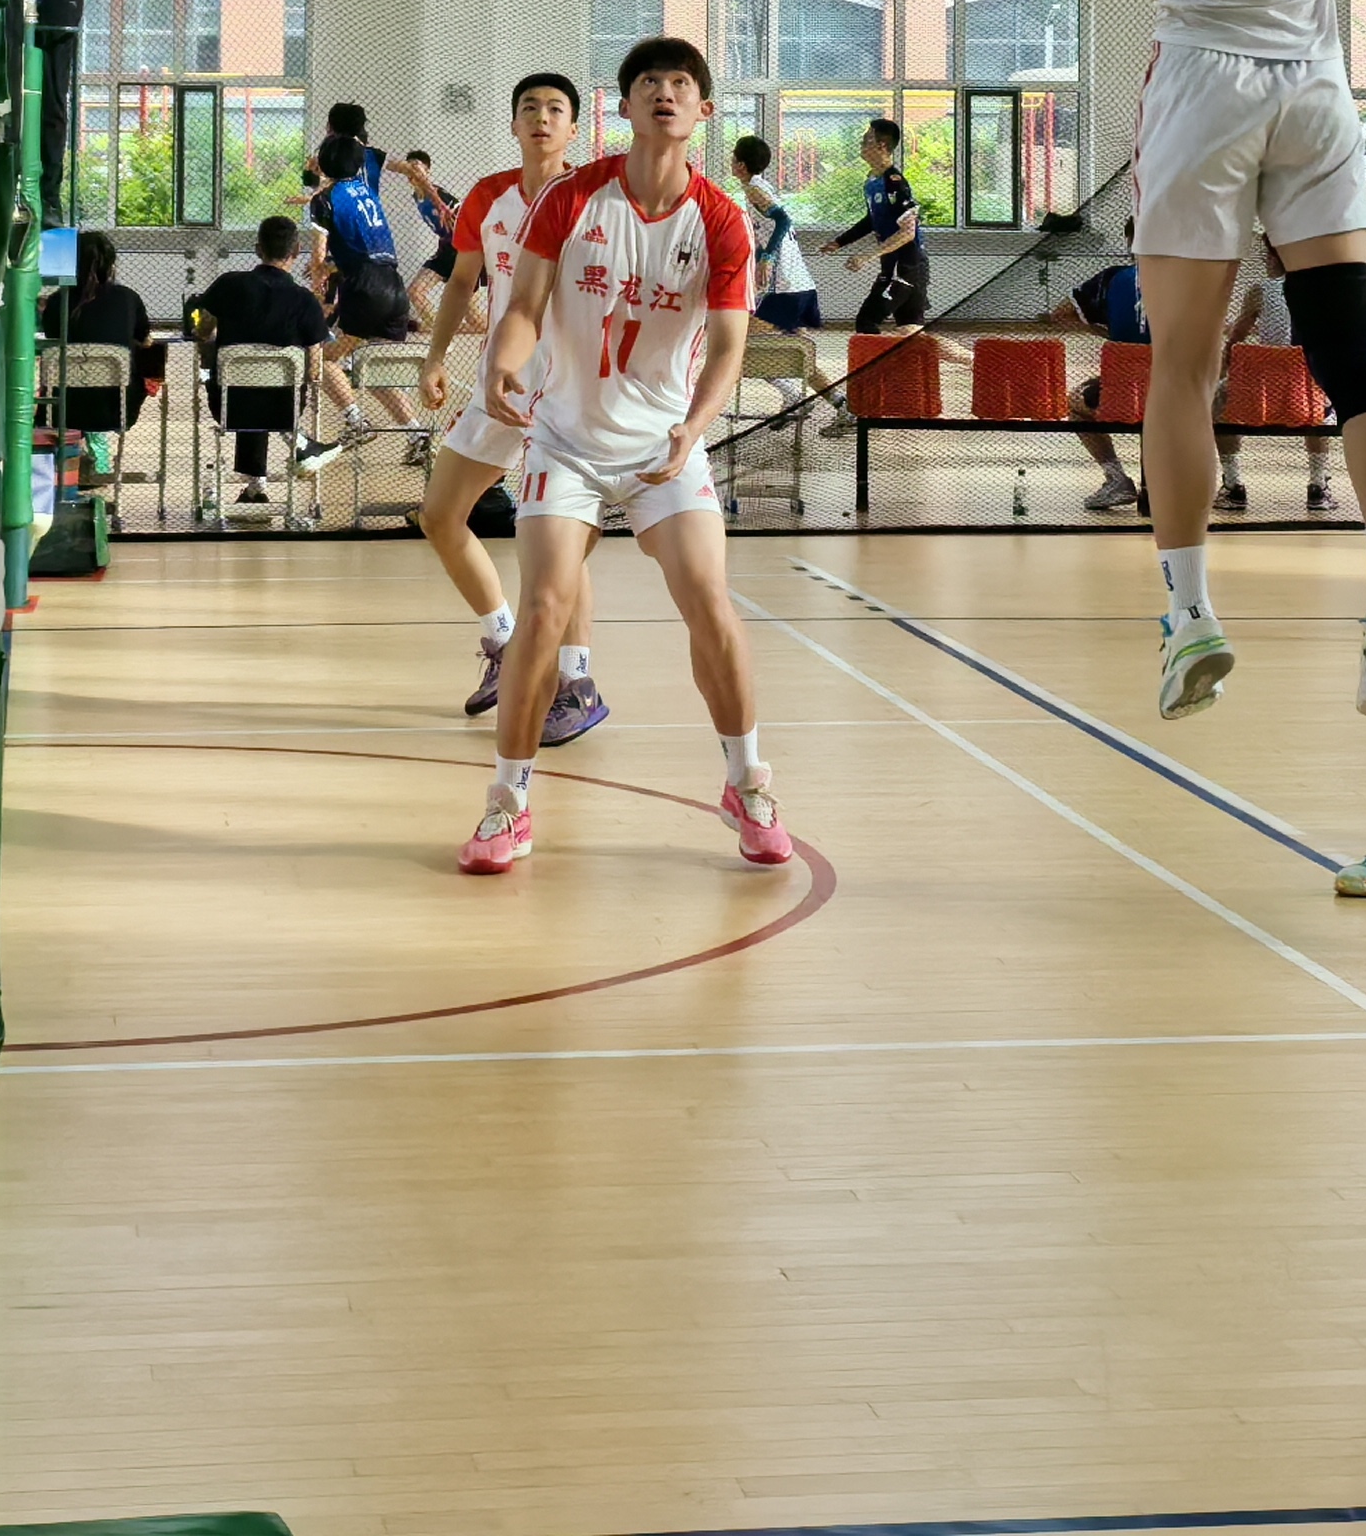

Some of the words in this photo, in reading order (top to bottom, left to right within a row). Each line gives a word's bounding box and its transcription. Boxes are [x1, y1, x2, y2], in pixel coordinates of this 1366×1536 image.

[357, 198, 383, 227] 12
[576, 265, 683, 312] 黑龙江
[599, 315, 641, 378] 11
[522, 472, 547, 503] 11
